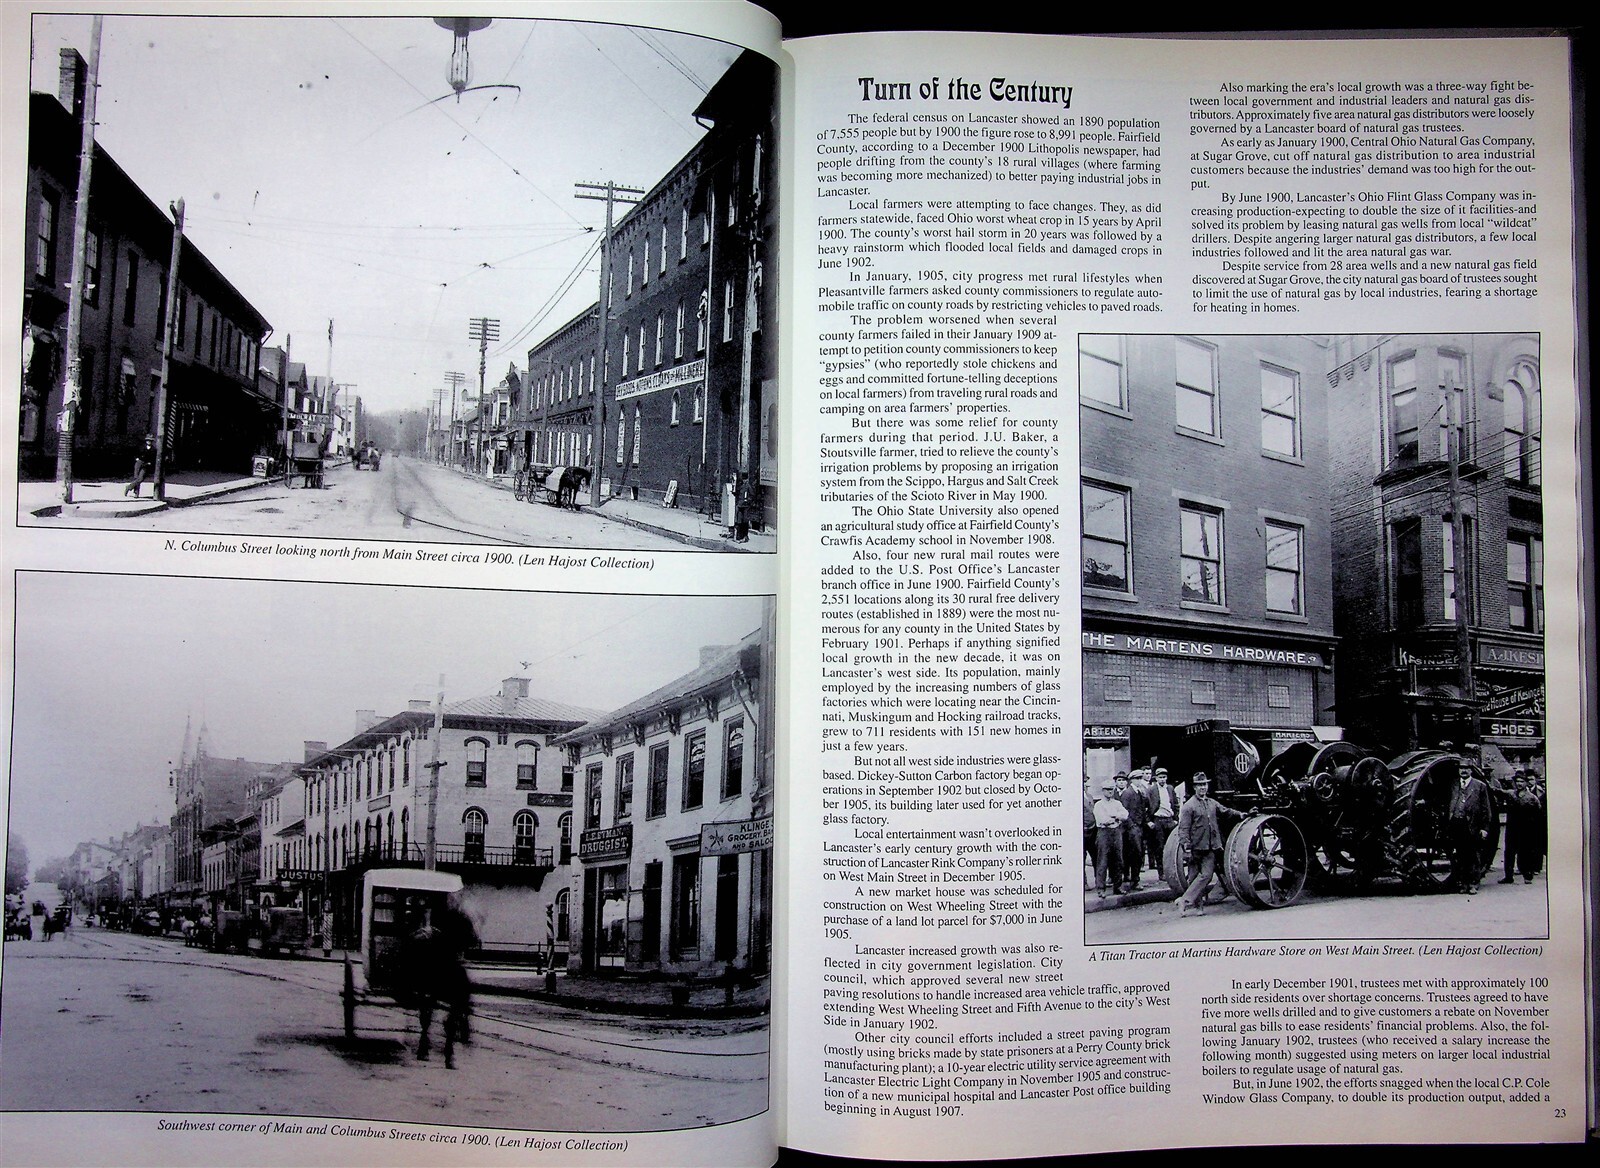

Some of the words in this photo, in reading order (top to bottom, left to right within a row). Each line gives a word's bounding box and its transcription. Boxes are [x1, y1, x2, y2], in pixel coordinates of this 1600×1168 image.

[858, 77, 911, 101] Turn
[919, 77, 939, 100] of
[948, 77, 981, 100] the
[989, 77, 1073, 109] Century
[847, 113, 868, 124] The
[873, 112, 909, 123] federal
[969, 112, 1018, 124] Lancaster
[1021, 114, 1060, 125] showed
[1063, 118, 1075, 126] an
[1080, 116, 1104, 127] 1890
[1106, 116, 1160, 131] population
[1190, 123, 1237, 136] governed
[1240, 123, 1253, 136] by
[1265, 123, 1314, 133] Lancaster
[1317, 123, 1346, 133] board
[1349, 122, 1361, 133] of
[1363, 123, 1399, 133] natural
[1402, 125, 1419, 135] gas
[1422, 124, 1465, 132] trustees.
[1192, 233, 1230, 243] drillers.
[1234, 233, 1272, 246] Despite
[1275, 233, 1320, 246] angering
[1323, 233, 1353, 246] larger
[1356, 233, 1391, 243] natural
[1395, 235, 1412, 245] gas
[1415, 232, 1477, 243] distributors,
[1480, 234, 1486, 242] a
[1489, 231, 1509, 242] few
[1512, 231, 1537, 242] local
[819, 285, 885, 297] Pleasantville
[889, 285, 929, 295] farmers
[932, 285, 961, 295] asked
[964, 287, 999, 298] county
[1002, 286, 1078, 296] commissioners
[1081, 289, 1091, 297] to
[1094, 287, 1134, 300] regulate
[1137, 289, 1163, 298] auto-
[852, 506, 873, 516] The
[877, 506, 904, 516] Ohio
[908, 505, 934, 516] State
[939, 505, 993, 518] University
[998, 505, 1018, 515] also
[1022, 505, 1059, 518] opened
[164, 539, 176, 550] N.
[181, 539, 237, 553] Columbus
[239, 542, 272, 554] Street
[275, 543, 316, 559] looking
[319, 546, 350, 559] north
[352, 546, 380, 560] from
[382, 548, 412, 561] Main
[415, 549, 448, 561] Street
[451, 551, 479, 563] circa
[484, 552, 515, 565] 1900.
[518, 553, 544, 566] (Len
[548, 554, 587, 569] Hajost
[590, 556, 654, 571] Collection)
[1126, 636, 1214, 656] MARTENS
[822, 682, 874, 695] employed
[878, 682, 891, 695] by
[895, 682, 911, 692] the
[916, 682, 969, 695] increasing
[973, 681, 1017, 692] numbers
[1021, 680, 1033, 691] of
[1035, 680, 1061, 693] glass
[1185, 721, 1210, 735] TITAN
[1490, 723, 1535, 736] SHOES
[280, 871, 324, 881] JUSTUS
[823, 872, 836, 880] on
[839, 871, 864, 882] West
[867, 872, 894, 882] Main
[897, 872, 927, 883] Street
[930, 872, 940, 882] in
[943, 871, 995, 882] December
[999, 870, 1025, 881] 1905.
[1088, 952, 1096, 962] A
[1100, 951, 1125, 961] Titan
[1129, 950, 1167, 960] Tractor
[1169, 950, 1179, 958] at
[1182, 947, 1222, 958] Martins
[1225, 946, 1276, 957] Hardware
[1279, 946, 1306, 956] Store
[1326, 945, 1349, 955] West
[1352, 945, 1379, 955] Main
[1382, 945, 1415, 955] Street.
[1418, 945, 1442, 958] (Len
[1445, 945, 1481, 958] Hajost
[1484, 945, 1543, 957] Collection)
[855, 1032, 886, 1043] Other
[890, 1033, 910, 1046] city
[915, 1033, 954, 1044] council
[959, 1033, 993, 1043] efforts
[998, 1030, 1042, 1042] included
[1047, 1032, 1053, 1040] a
[1057, 1030, 1085, 1040] street
[1089, 1029, 1124, 1041] paving
[1128, 1027, 1171, 1041] program
[1202, 1094, 1245, 1104] Window
[1249, 1093, 1278, 1103] Glass
[1281, 1092, 1334, 1105] Company,
[1338, 1094, 1349, 1102] to
[1352, 1092, 1387, 1102] double
[1392, 1091, 1404, 1102] its
[1408, 1092, 1465, 1105] production
[1468, 1094, 1505, 1105] output,
[1509, 1092, 1541, 1102] added
[1544, 1094, 1551, 1102] a
[1554, 1108, 1567, 1118] 23
[157, 1119, 216, 1131] Southwest
[218, 1123, 257, 1132] corner
[259, 1121, 273, 1135] of
[273, 1122, 303, 1134] Main
[306, 1124, 328, 1135] and
[330, 1125, 386, 1139] Columbus
[389, 1128, 427, 1141] Streets
[429, 1132, 457, 1144] circa
[461, 1134, 491, 1146] 1900.
[495, 1136, 521, 1148] (Len
[524, 1137, 562, 1151] Hajost
[565, 1139, 628, 1152] Collection)
